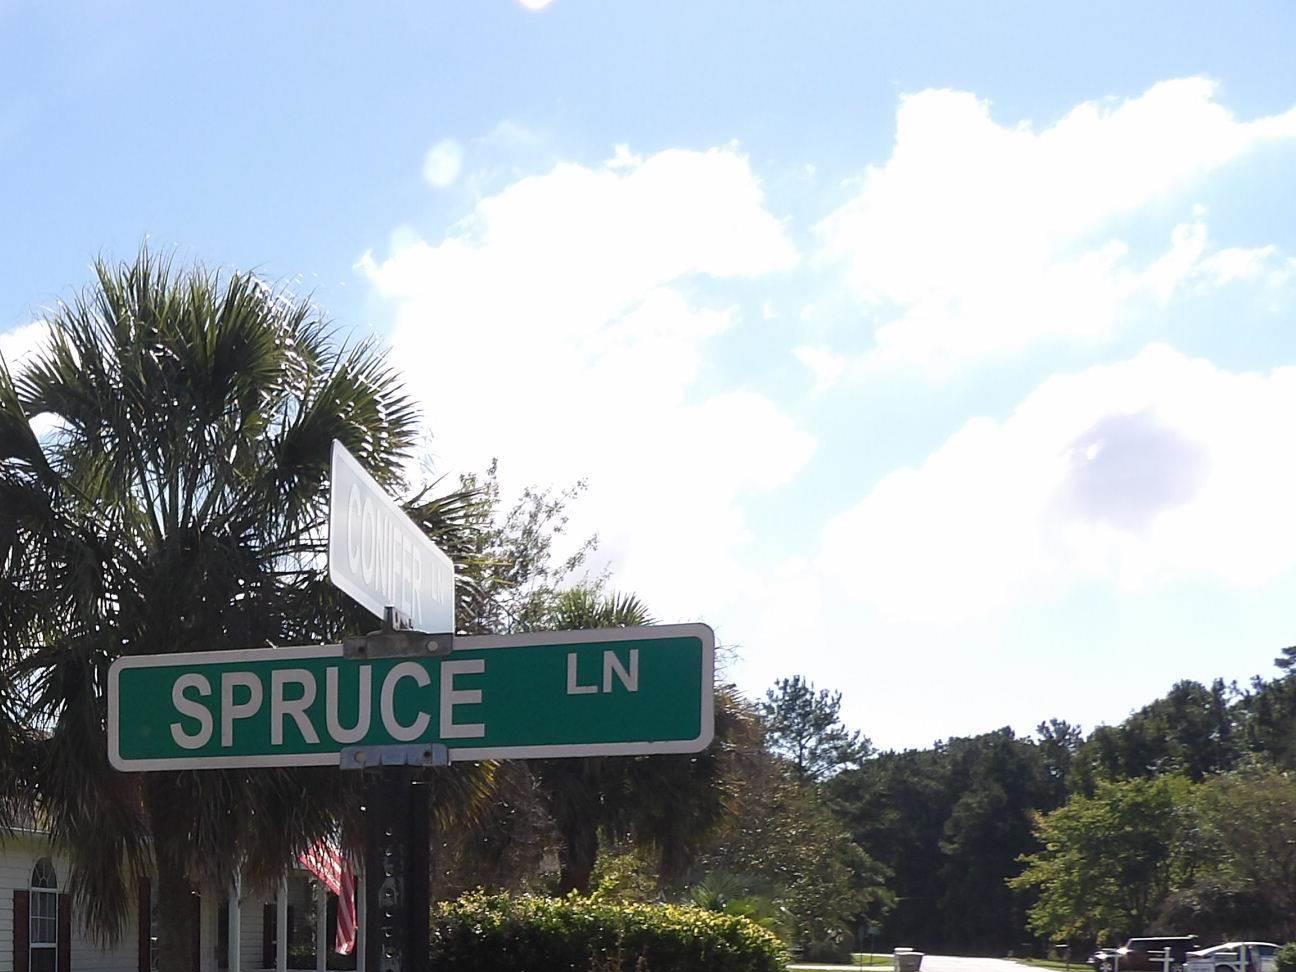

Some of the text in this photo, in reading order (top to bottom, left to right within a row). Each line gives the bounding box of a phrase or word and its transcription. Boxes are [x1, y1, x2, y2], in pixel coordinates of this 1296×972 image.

[347, 484, 423, 626] CONIFER
[170, 649, 639, 750] SPRUCE LN
